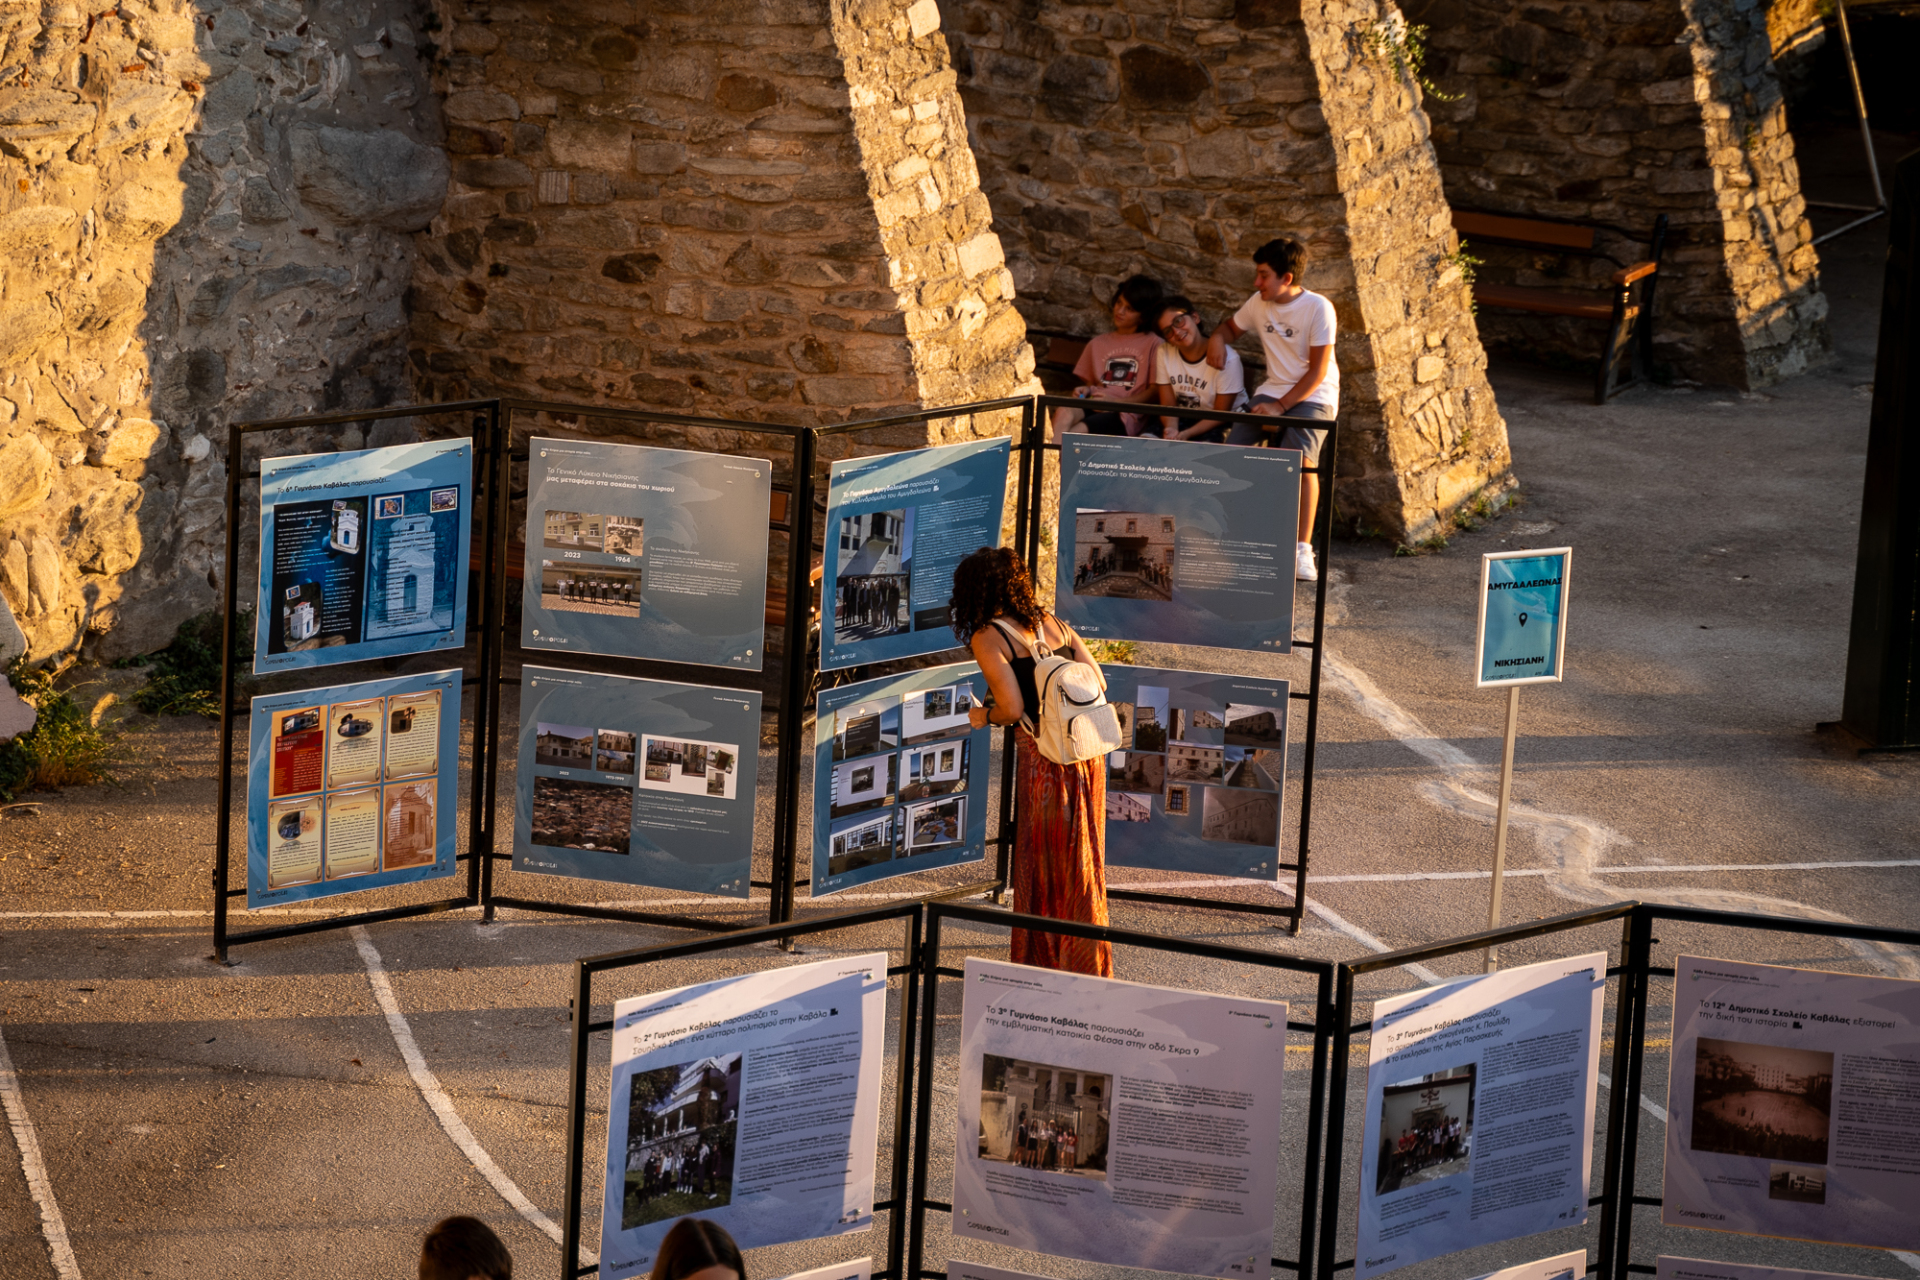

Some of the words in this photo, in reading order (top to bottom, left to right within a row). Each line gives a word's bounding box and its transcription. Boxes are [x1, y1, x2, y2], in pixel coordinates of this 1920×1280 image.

[1170, 374, 1207, 390] GOLDEN
[556, 467, 577, 476] Γενικό
[578, 469, 601, 478] Λύκειο
[602, 472, 639, 482] Νικήσιανης
[1078, 468, 1118, 479] παρουσιάζει
[1128, 472, 1173, 482] Καπνομάγαζο
[1174, 475, 1220, 486] Αμυγδαλεώνα
[1087, 461, 1118, 471] Δημοτικό
[1119, 463, 1146, 472] Σχολείο
[1146, 465, 1193, 476] Αμυγδαλεώνα
[546, 476, 560, 484] μας
[560, 475, 595, 486] μεταφέρει
[609, 479, 636, 489] σοκάκια
[651, 483, 675, 493] χωριού
[564, 551, 581, 559] 2023
[615, 556, 631, 564] 1964
[1494, 656, 1544, 668] ΝΙΚΗΣΙΑΝΗ
[986, 1005, 996, 1014] Το
[1010, 1008, 1048, 1024] Γυμνάσιο
[1050, 1014, 1088, 1030] Καβάλας
[1090, 1022, 1144, 1038] παρουσιάζει
[1404, 1024, 1432, 1040] Γυμνάσιο
[1434, 1018, 1462, 1033] Καβάλας
[1462, 1008, 1502, 1026] παρουσιάζει
[1698, 1011, 1714, 1020] την
[1716, 1012, 1735, 1024] δική
[1738, 1016, 1752, 1024] του
[1755, 1017, 1787, 1028] ιστορία
[1700, 1000, 1710, 1008] Το
[1728, 1003, 1770, 1016] Δημοτικό
[1772, 1008, 1808, 1020] Σχολείο
[1810, 1012, 1850, 1025] Καβάλας
[1853, 1018, 1896, 1030] εξιστορεί
[632, 1040, 668, 1055] Σουηδικό
[668, 1036, 685, 1049] Σπίτι
[691, 1032, 705, 1043] ένα
[706, 1026, 736, 1041] κύτταρο
[737, 1017, 778, 1035] πολιτισμού
[779, 1014, 796, 1027] στην
[798, 1008, 828, 1022] Καβάλα
[633, 1036, 642, 1044] Το
[654, 1025, 688, 1041] Γυμνάσιο
[689, 1020, 721, 1034] Καβάλας
[723, 1010, 768, 1028] παρουσιάζει
[770, 1008, 778, 1016] το
[1427, 1034, 1437, 1044] της
[1438, 1025, 1474, 1042] οικογένειας
[1476, 1024, 1482, 1032] Κ.
[1483, 1016, 1510, 1030] Πουλίδη
[986, 1016, 999, 1027] την
[1002, 1019, 1054, 1037] εμβληματική
[1056, 1028, 1092, 1042] κατοικία
[1093, 1033, 1124, 1047] Φέσσα
[1126, 1038, 1146, 1050] στην
[1148, 1041, 1167, 1052] οδό
[1168, 1046, 1191, 1058] Σκρα
[1194, 1048, 1199, 1057] 9
[1400, 1046, 1432, 1061] εκκλησάκι
[1433, 1044, 1443, 1054] της
[1444, 1037, 1462, 1051] Αγίας
[1463, 1028, 1504, 1046] Παρασκευής
